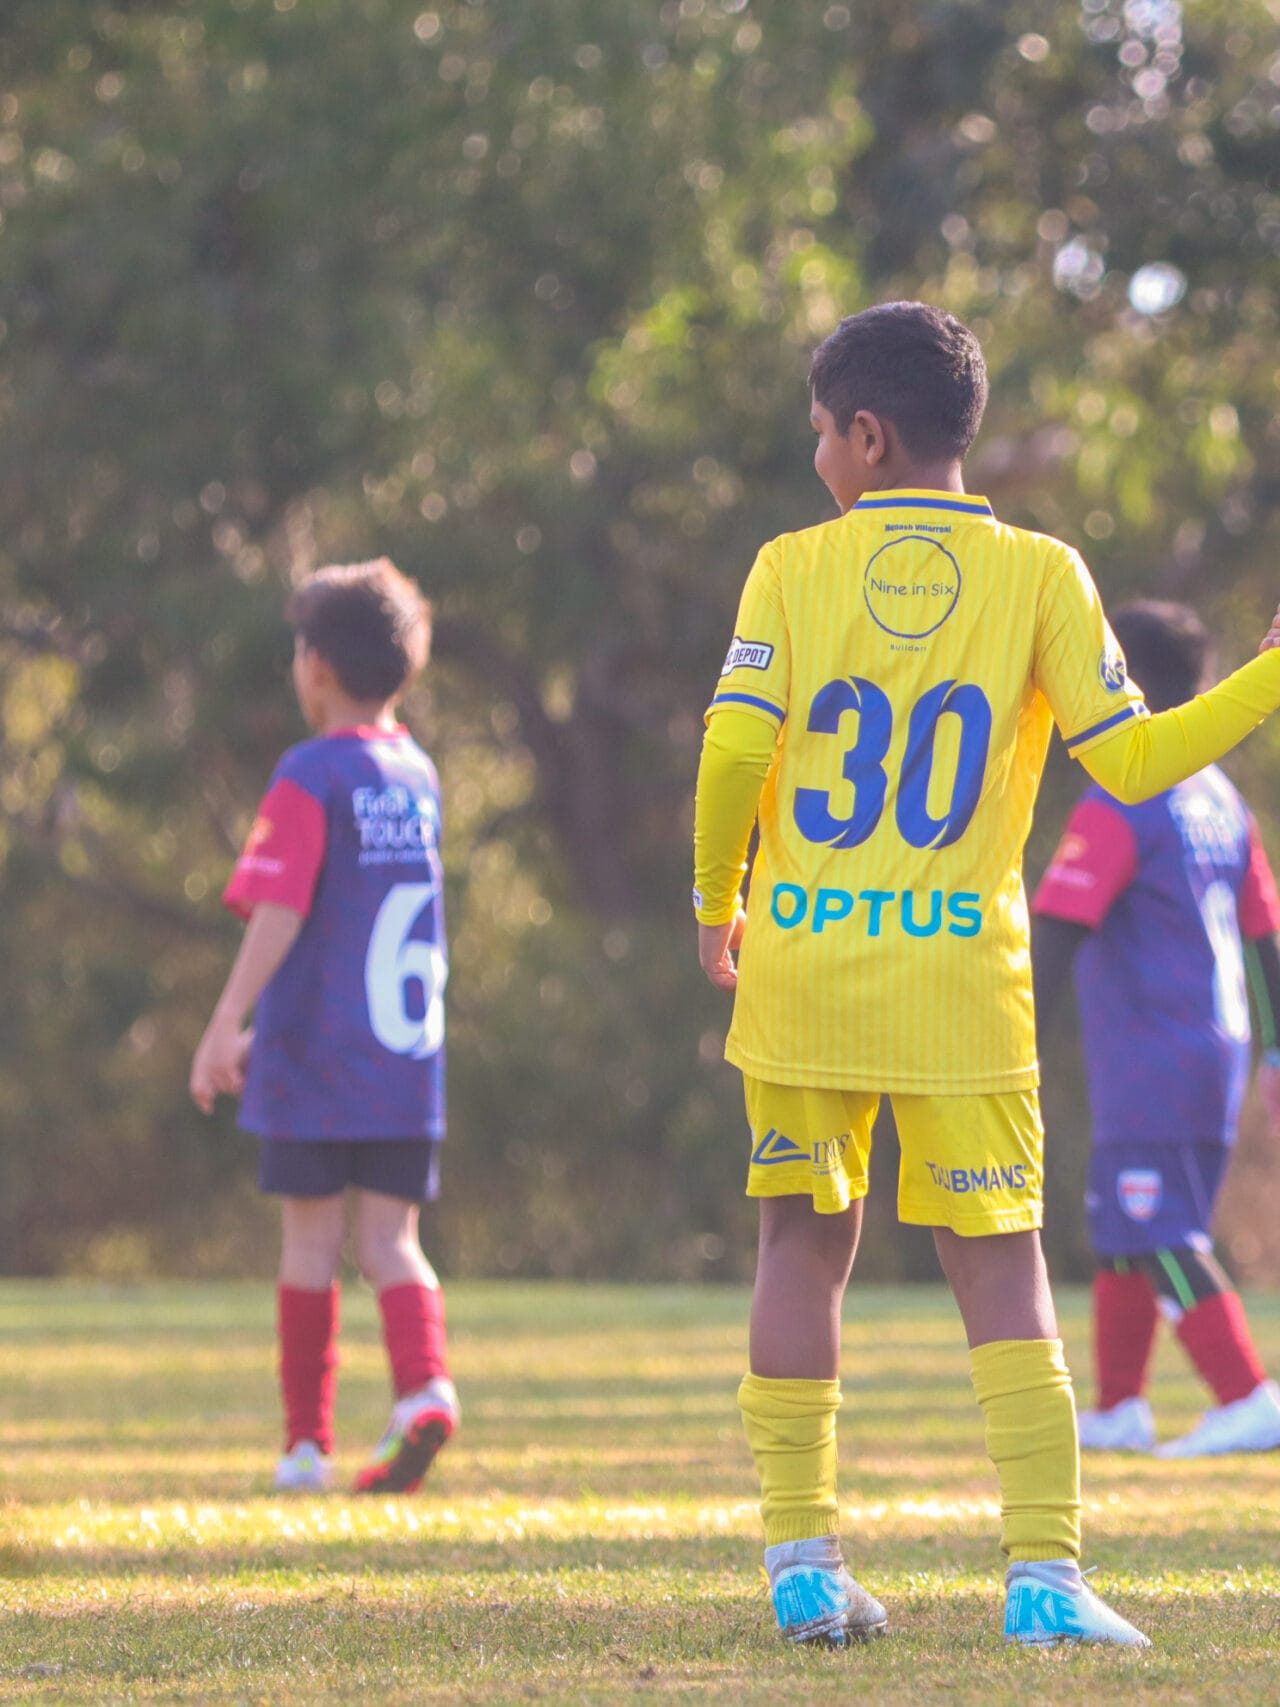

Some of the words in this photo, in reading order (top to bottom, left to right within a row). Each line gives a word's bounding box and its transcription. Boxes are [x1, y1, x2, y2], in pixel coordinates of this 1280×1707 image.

[871, 578, 906, 595] Nine
[912, 583, 926, 595] in
[932, 583, 955, 597] Six
[733, 647, 767, 664] DEPOT
[792, 674, 992, 850] 30
[771, 882, 983, 938] OPTUS
[364, 881, 446, 1055] 6
